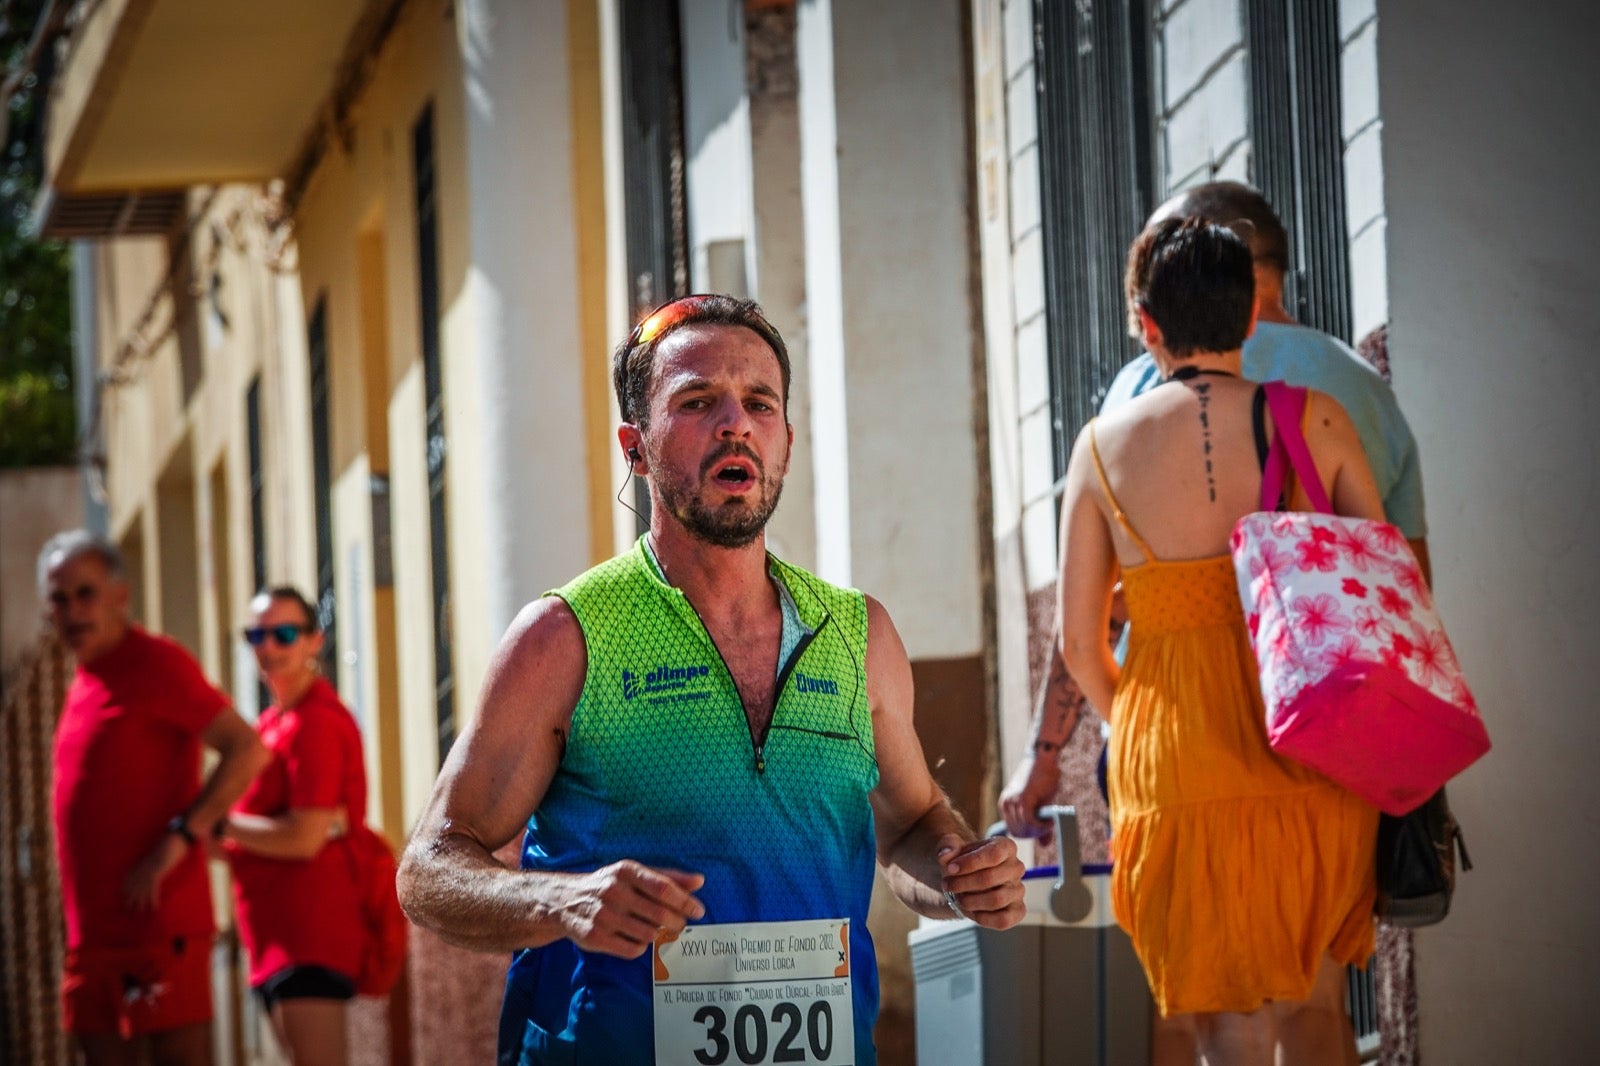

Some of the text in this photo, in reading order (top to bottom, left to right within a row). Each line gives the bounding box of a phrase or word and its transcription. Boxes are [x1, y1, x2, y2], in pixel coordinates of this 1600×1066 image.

[681, 940, 707, 957] XXXV
[774, 938, 785, 953] DE
[789, 935, 816, 952] FONDO
[693, 1000, 833, 1065] 3020
